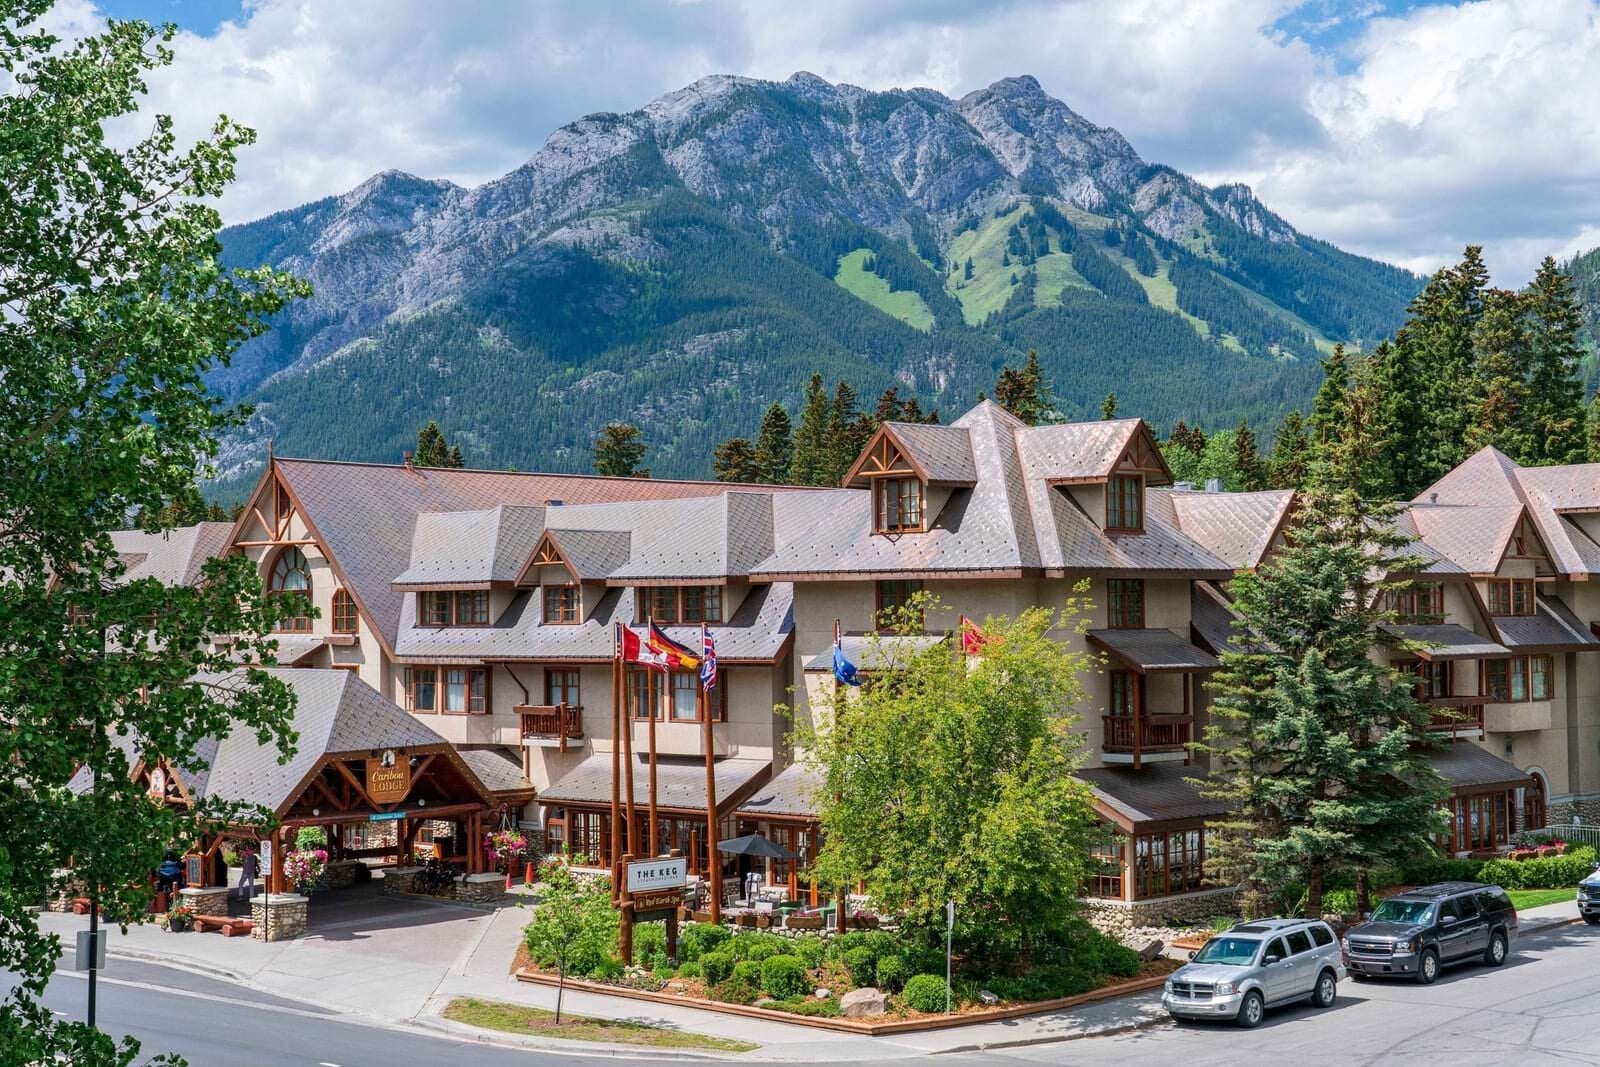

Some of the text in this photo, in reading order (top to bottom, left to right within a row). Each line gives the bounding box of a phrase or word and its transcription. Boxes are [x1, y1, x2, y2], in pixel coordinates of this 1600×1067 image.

[372, 770, 404, 782] Caribou
[373, 781, 404, 792] LODGE
[638, 867, 677, 878] THE KEG
